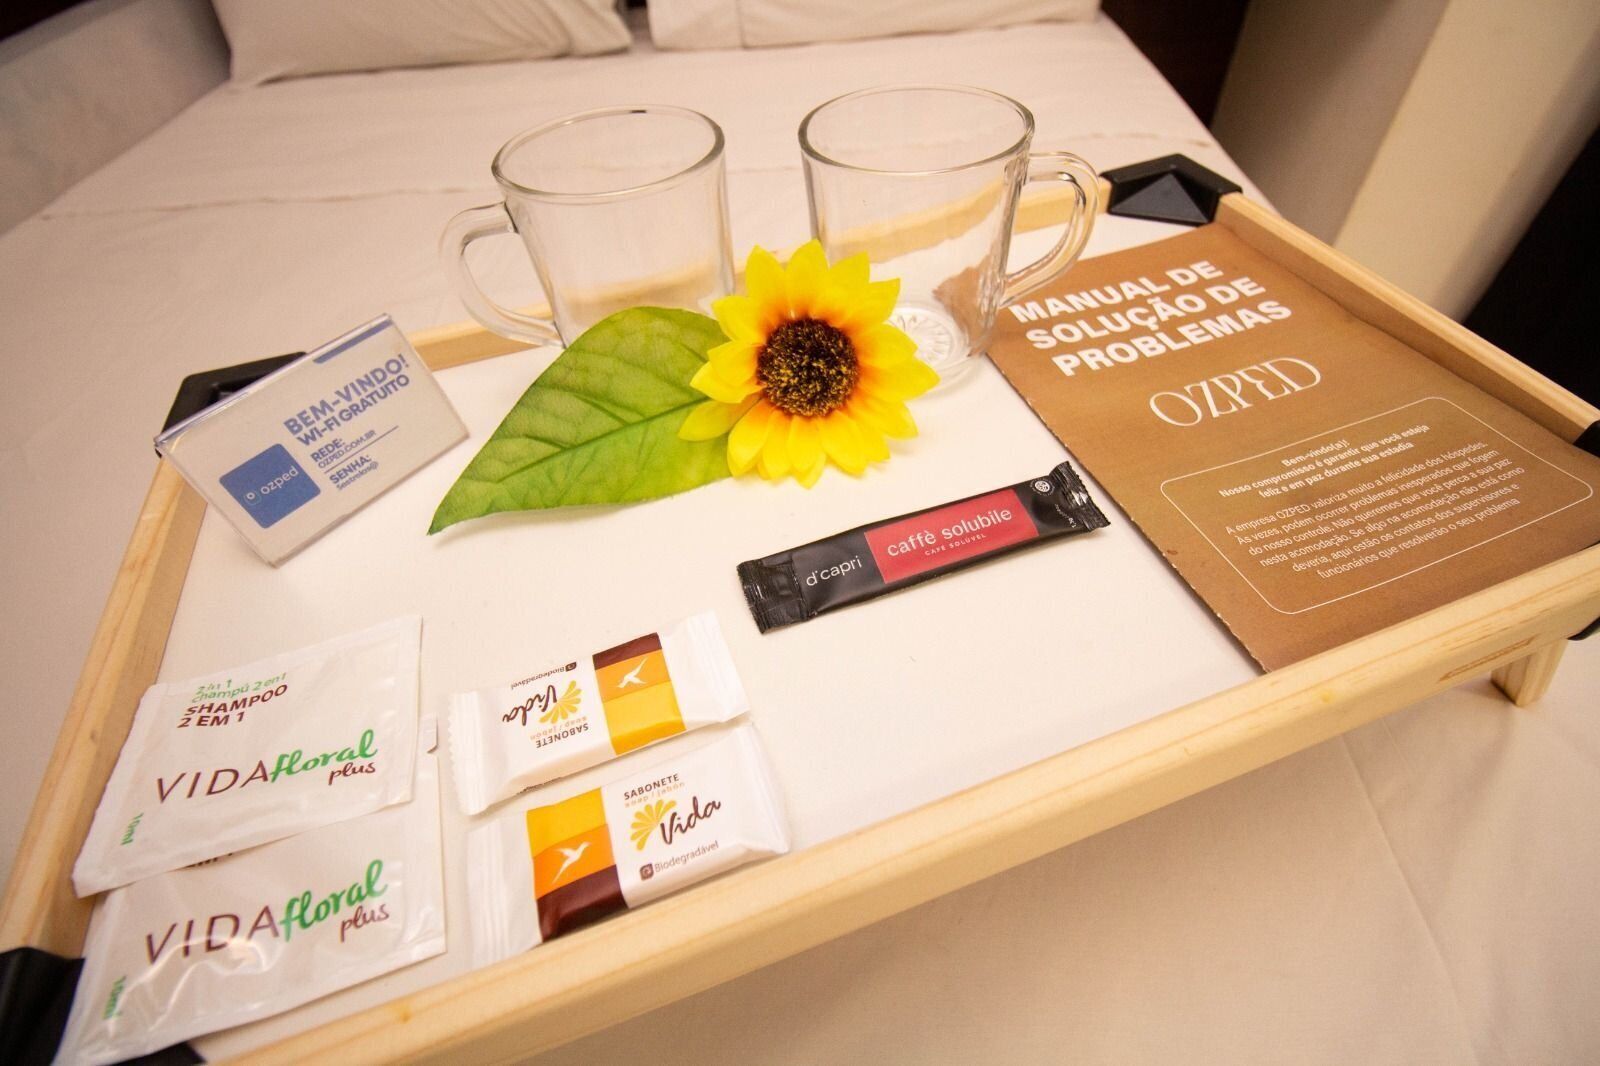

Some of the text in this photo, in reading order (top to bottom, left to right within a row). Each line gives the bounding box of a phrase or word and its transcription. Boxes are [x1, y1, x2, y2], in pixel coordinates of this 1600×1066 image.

[1008, 261, 1223, 323] MANUAL DE
[1026, 277, 1266, 349] SOLUÇÃO DE
[1052, 300, 1292, 377] PROBLEMAS
[283, 353, 409, 436] BEM-VINDO!
[297, 374, 410, 446] WI-FI GRATUITO
[1149, 357, 1321, 427] OZPED
[310, 438, 346, 462] REDE:
[329, 454, 372, 484] SENHA:
[1218, 483, 1251, 497] Nosso
[1251, 463, 1315, 488] compromisso
[1323, 447, 1360, 466] garantir
[1360, 441, 1380, 453] que
[1378, 433, 1402, 446] você
[1401, 424, 1430, 438] esteja
[1259, 487, 1282, 498] feliz
[1288, 480, 1306, 489] em
[1305, 473, 1324, 486] paz
[1324, 459, 1362, 478] durante
[1361, 453, 1380, 464] sua
[1379, 442, 1414, 458] estadia
[1281, 439, 1350, 467] Bem-vindo(a)!
[260, 465, 299, 495] ozped
[1225, 526, 1236, 535] A
[1235, 514, 1277, 532] empresa
[1276, 504, 1311, 519] OZPED
[1311, 492, 1348, 509] valoriza
[1347, 482, 1375, 497] muito
[1374, 479, 1383, 487] a
[1381, 463, 1426, 484] felicidade
[1425, 456, 1444, 467] dos
[1252, 526, 1283, 540] vezes,
[1282, 517, 1315, 533] podem
[1315, 505, 1349, 522] ocorrer
[1349, 486, 1399, 511] problemas
[1398, 467, 1454, 492] inesperados
[1452, 460, 1471, 471] que
[1467, 449, 1500, 463] fogem
[1248, 546, 1263, 556] do
[1263, 538, 1293, 551] nosso
[1331, 518, 1355, 530] Não
[1355, 500, 1402, 522] queremos
[1401, 493, 1421, 505] que
[1419, 483, 1443, 497] você
[1443, 474, 1470, 490] perca
[1476, 465, 1495, 476] sua
[1494, 458, 1513, 470] paz
[1260, 553, 1288, 567] nesta
[1349, 528, 1366, 537] Se
[1365, 520, 1387, 533] algo
[1386, 515, 1401, 525] na
[1400, 492, 1460, 520] acomodação
[1459, 485, 1479, 497] não
[1477, 476, 1500, 489] está
[1497, 467, 1525, 481] como
[1331, 546, 1354, 561] aqui
[1353, 538, 1380, 552] estão
[1380, 533, 1394, 542] os
[1394, 517, 1436, 536] contatos
[1434, 511, 1455, 521] dos
[1453, 486, 1513, 513] supervisores
[887, 508, 1012, 557] caffè solubile
[1317, 498, 1521, 579] funcionários que resolverão o seu problema
[184, 684, 288, 716] SHAMPOO
[511, 666, 565, 690] Biodegradável
[177, 711, 245, 728] 2 EM 1
[502, 685, 557, 726] Vida
[536, 723, 589, 748] SABONETE
[328, 760, 376, 786] plus
[624, 773, 680, 800] SABONETE
[660, 796, 721, 845] Vida
[654, 840, 719, 873] Biodegradável
[339, 902, 389, 943] plus
